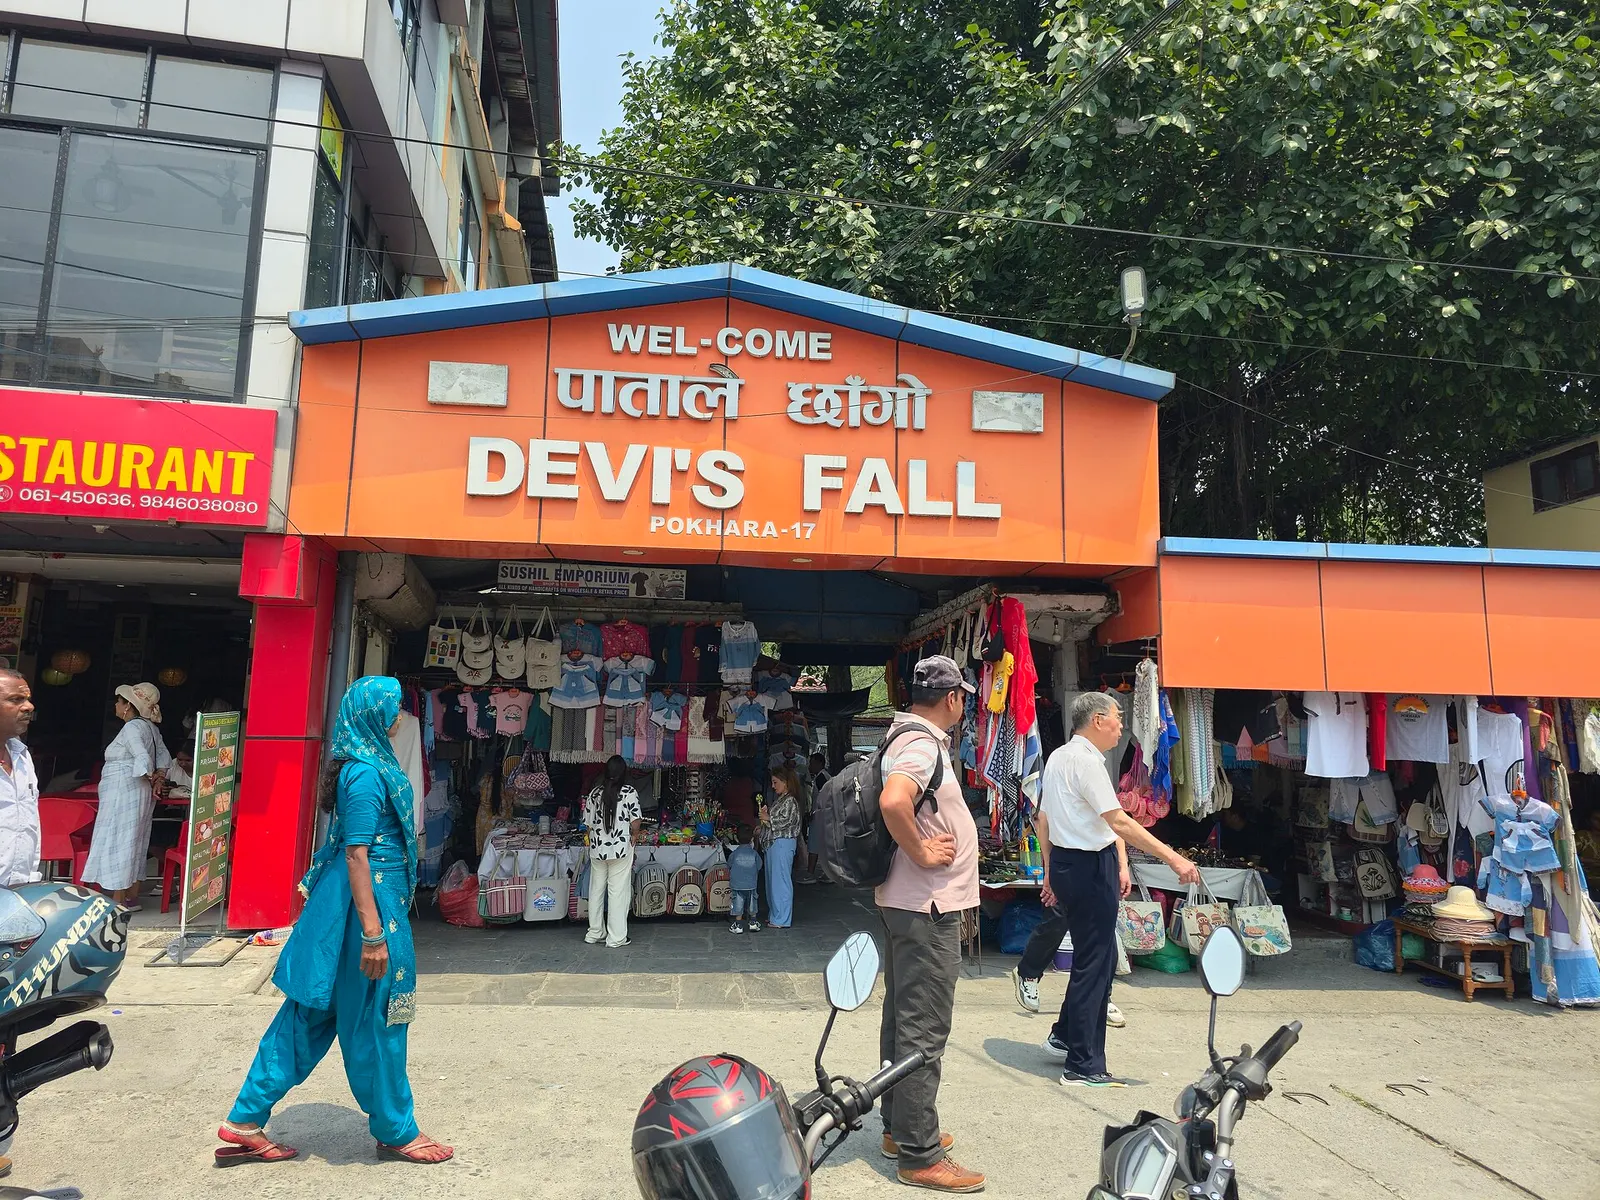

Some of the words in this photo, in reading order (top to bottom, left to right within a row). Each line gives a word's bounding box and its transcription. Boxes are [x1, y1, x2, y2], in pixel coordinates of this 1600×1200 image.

[607, 323, 833, 361] WEL-COME
[553, 363, 746, 421] पाताले
[466, 436, 746, 510] DEVI'S
[803, 454, 1002, 519] FALL
[19, 488, 136, 508] 061-450636,
[139, 495, 259, 514] 9846038080
[649, 515, 817, 540] POKHARA-17
[500, 565, 549, 580] SUSHIL
[555, 568, 629, 584] EMPORIUM
[528, 585, 559, 593] HANDICRAFTS
